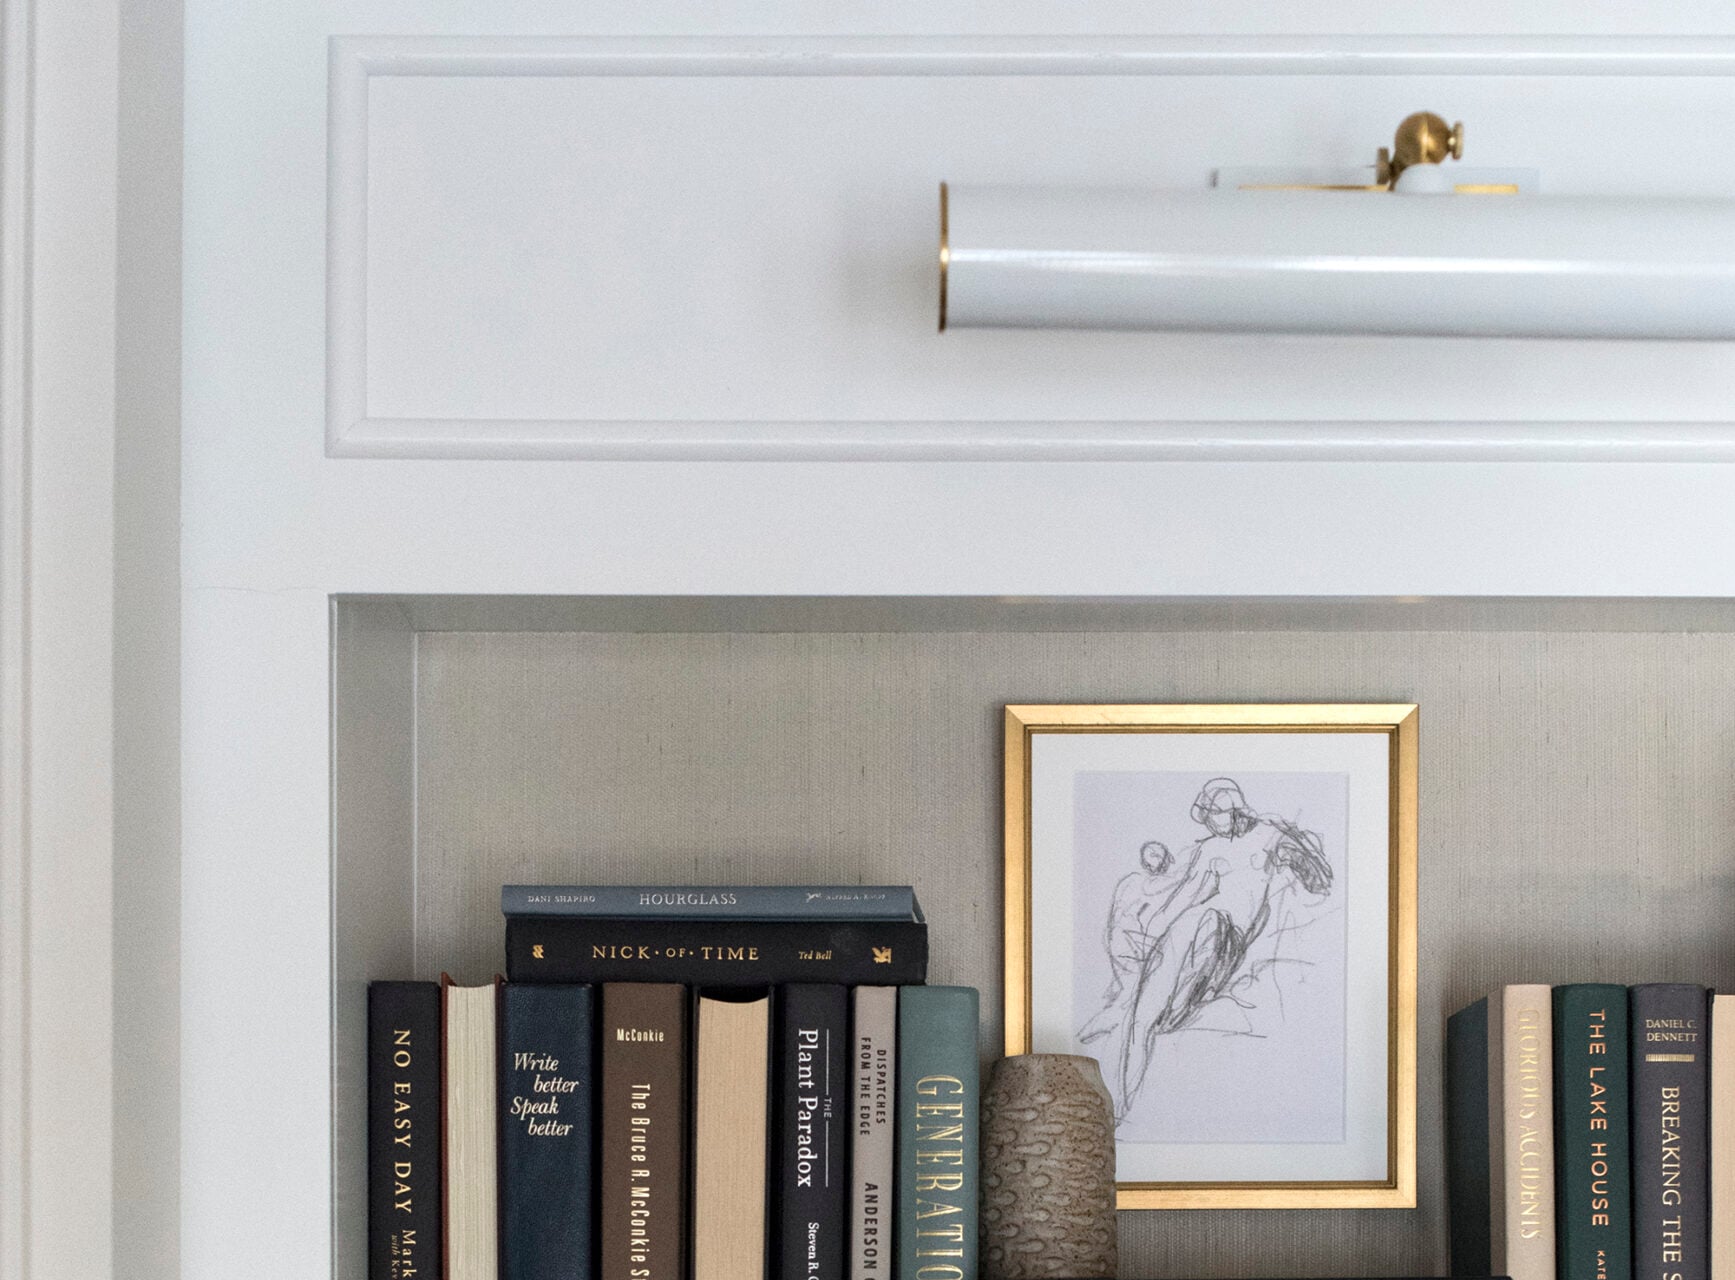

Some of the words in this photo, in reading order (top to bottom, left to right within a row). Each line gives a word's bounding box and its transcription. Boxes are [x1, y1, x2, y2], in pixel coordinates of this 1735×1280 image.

[639, 893, 737, 905] HOURGLASS
[701, 946, 759, 961] TIME
[798, 950, 814, 960] Ted
[815, 950, 832, 960] Bell
[616, 1028, 665, 1042] McConkie
[1589, 1009, 1606, 1055] THE
[1645, 1019, 1684, 1028] DANIEL
[1687, 1019, 1697, 1028] C.
[1646, 1032, 1698, 1042] DENNETT
[393, 1029, 412, 1068] NO
[513, 1053, 559, 1071] Write
[798, 1028, 819, 1089] Plant
[861, 1037, 871, 1070] FROM
[1518, 1008, 1542, 1120] GLORIOUS
[534, 1074, 579, 1093] better
[631, 1083, 651, 1110] The
[860, 1076, 871, 1099] THE
[876, 1049, 887, 1124] DISPATCHES
[1590, 1067, 1607, 1131] LAKE
[394, 1081, 412, 1148] EASY
[510, 1096, 559, 1120] Speak
[823, 1097, 832, 1118] THE
[860, 1105, 871, 1136] EDGE
[528, 1117, 573, 1136] better
[631, 1117, 651, 1162] Bruce
[797, 1095, 818, 1187] Paradox
[1661, 1086, 1681, 1206] BREAKING
[394, 1161, 412, 1214] DAY
[631, 1169, 651, 1182] R.
[1591, 1142, 1609, 1226] HOUSE
[630, 1186, 651, 1262] McConkie
[864, 1182, 879, 1270] ANDERSON
[1662, 1215, 1682, 1263] THE
[391, 1234, 401, 1256] with
[402, 1229, 417, 1278] Mark
[808, 1222, 819, 1259] Steven
[808, 1261, 819, 1273] R.
[1597, 1250, 1606, 1280] KATE
